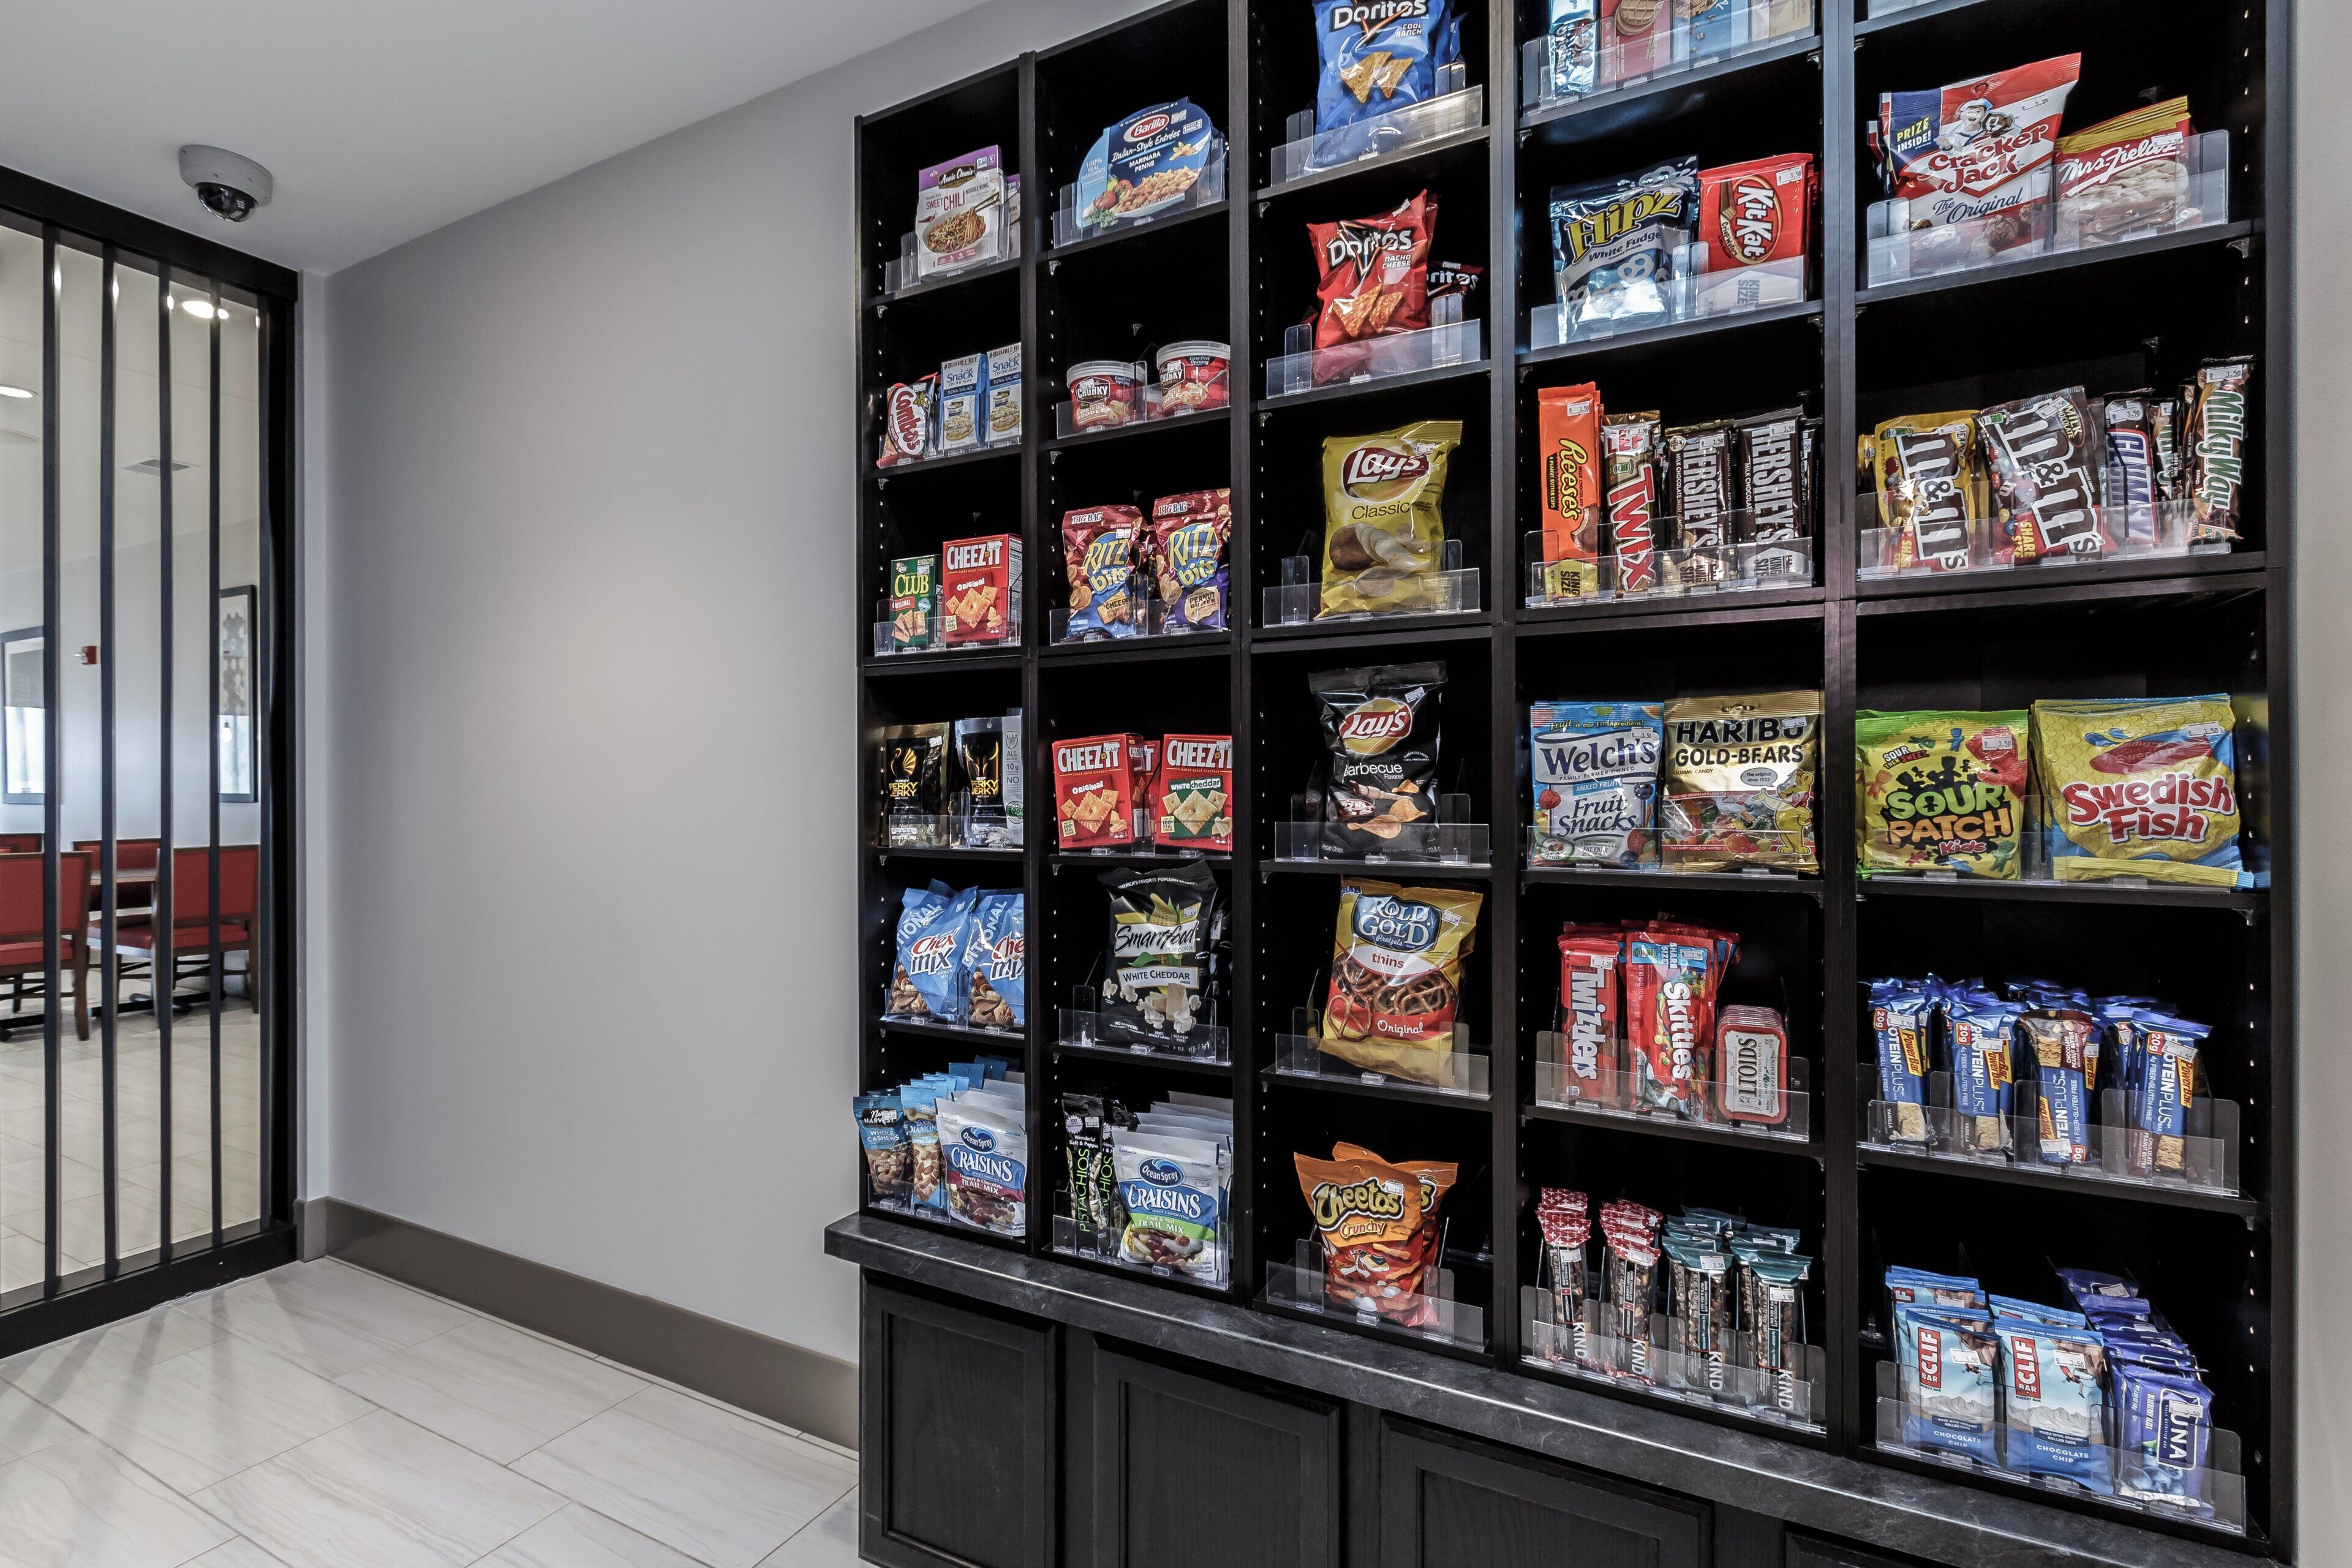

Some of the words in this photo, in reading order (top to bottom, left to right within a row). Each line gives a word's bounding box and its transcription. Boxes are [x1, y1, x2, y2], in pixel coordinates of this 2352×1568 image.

[1334, 0, 1428, 29] Doritos
[1395, 29, 1422, 39] RANCH
[1134, 118, 1166, 137] Barilla
[1897, 117, 1930, 142] PRIZE
[1898, 134, 1931, 153] INSIDE!
[1929, 124, 2048, 170] Cracker
[1086, 157, 1102, 168] 100%
[1129, 151, 1161, 168] MARINARA
[1135, 160, 1155, 173] PENNE
[1081, 167, 1106, 179] INGREDIENTS
[1943, 154, 2019, 194] Jack
[926, 198, 943, 210] SWEET
[943, 191, 965, 211] CHILI
[1932, 197, 1955, 215] The
[1946, 187, 2022, 224] Original
[1567, 191, 1680, 264] Flipz
[1328, 230, 1414, 266] Doritos
[1589, 245, 1623, 262] White
[1626, 231, 1661, 248] Fudge
[1609, 251, 1624, 259] Covered
[1625, 244, 1642, 255] Pretzels
[1382, 260, 1411, 270] CHEESE
[948, 359, 967, 368] BUMBLE
[993, 358, 1019, 372] Snack
[947, 371, 974, 383] Snack
[1077, 386, 1107, 398] CHUNKY
[2062, 404, 2082, 437] MILK
[2196, 390, 2244, 458] Milky
[1348, 450, 1424, 485] Lay's
[1559, 439, 1588, 520] Reese's
[2195, 458, 2242, 510] Way
[1072, 514, 1087, 524] BIG
[1088, 512, 1102, 521] BAG
[1159, 505, 1172, 515] BIG
[1174, 502, 1187, 513] BAG
[1352, 500, 1410, 520] Classic
[1608, 464, 1655, 591] TWIX
[2020, 522, 2035, 557] SHARE
[1083, 538, 1129, 575] RITZ
[1169, 527, 1216, 568] RITZ
[1093, 568, 1128, 592] bits
[1179, 560, 1216, 586] bits
[1561, 570, 1570, 595] SIZE
[1570, 571, 1580, 595] KING
[895, 575, 929, 597] CLUB
[1189, 592, 1215, 604] PEANUT
[1106, 598, 1128, 609] CHEESE
[1191, 599, 1215, 608] BUTTER
[1343, 709, 1406, 739] Lay's
[1675, 717, 1804, 744] HARIBO
[1540, 737, 1656, 775] Welch's
[1675, 745, 1803, 767] GOLD-BEARS
[1883, 746, 1909, 761] SOUR
[1884, 759, 1900, 769] THEN
[1901, 750, 1929, 764] SWEET
[1576, 783, 1597, 792] MIXED
[1599, 778, 1622, 788] FRUIT
[1583, 770, 1608, 779] FARMER
[1571, 794, 1627, 819] Fruit
[1888, 782, 2002, 819] SOUR
[2063, 774, 2233, 823] Swedish
[1557, 812, 1637, 837] Snacks
[1890, 808, 2011, 845] PATCH
[2103, 807, 2205, 841] Fish
[1940, 840, 1987, 856] Kids
[1370, 897, 1429, 922] ROLD
[1115, 921, 1199, 952] Smartfood
[1358, 914, 1430, 946] GOLD
[1376, 933, 1403, 946] Pretzels
[913, 934, 954, 955] Chex
[912, 949, 951, 973] mix
[1371, 952, 1404, 969] thins
[1150, 970, 1190, 980] CHEDDAR
[1377, 1020, 1424, 1037] Original
[1663, 982, 1693, 1079] Skittles
[1875, 1011, 1884, 1028] 20g
[1959, 1025, 1968, 1042] 20g
[2149, 1033, 2160, 1052] 20g
[1902, 1033, 1919, 1073] PowerBar
[2182, 1060, 2193, 1108] PowerBar
[951, 1147, 1012, 1182] CRAISINS
[962, 1178, 981, 1189] TRAIL
[983, 1184, 999, 1195] MIX
[1076, 1148, 1091, 1232] PISTACHIOS
[1128, 1184, 1200, 1218] CRAISINS
[1315, 1180, 1403, 1225] Cheetos
[1166, 1223, 1185, 1234] MIX
[1340, 1219, 1385, 1238] Crunchy
[1573, 1323, 1588, 1359] KIND
[1921, 1332, 1939, 1374] CLIF
[1632, 1339, 1646, 1374] KIND
[2018, 1341, 2036, 1384] CLIF
[1709, 1352, 1723, 1390] KIND
[1921, 1374, 1938, 1382] BAR
[1779, 1370, 1793, 1409] KIND
[2019, 1384, 2037, 1393] BAR
[2146, 1394, 2155, 1417] BLUEBERRY
[2145, 1419, 2154, 1430] BLISS
[1934, 1431, 1982, 1443] CHOCOLATE
[2037, 1444, 2089, 1458] CHOCOLATE
[2052, 1454, 2074, 1463] CHIP
